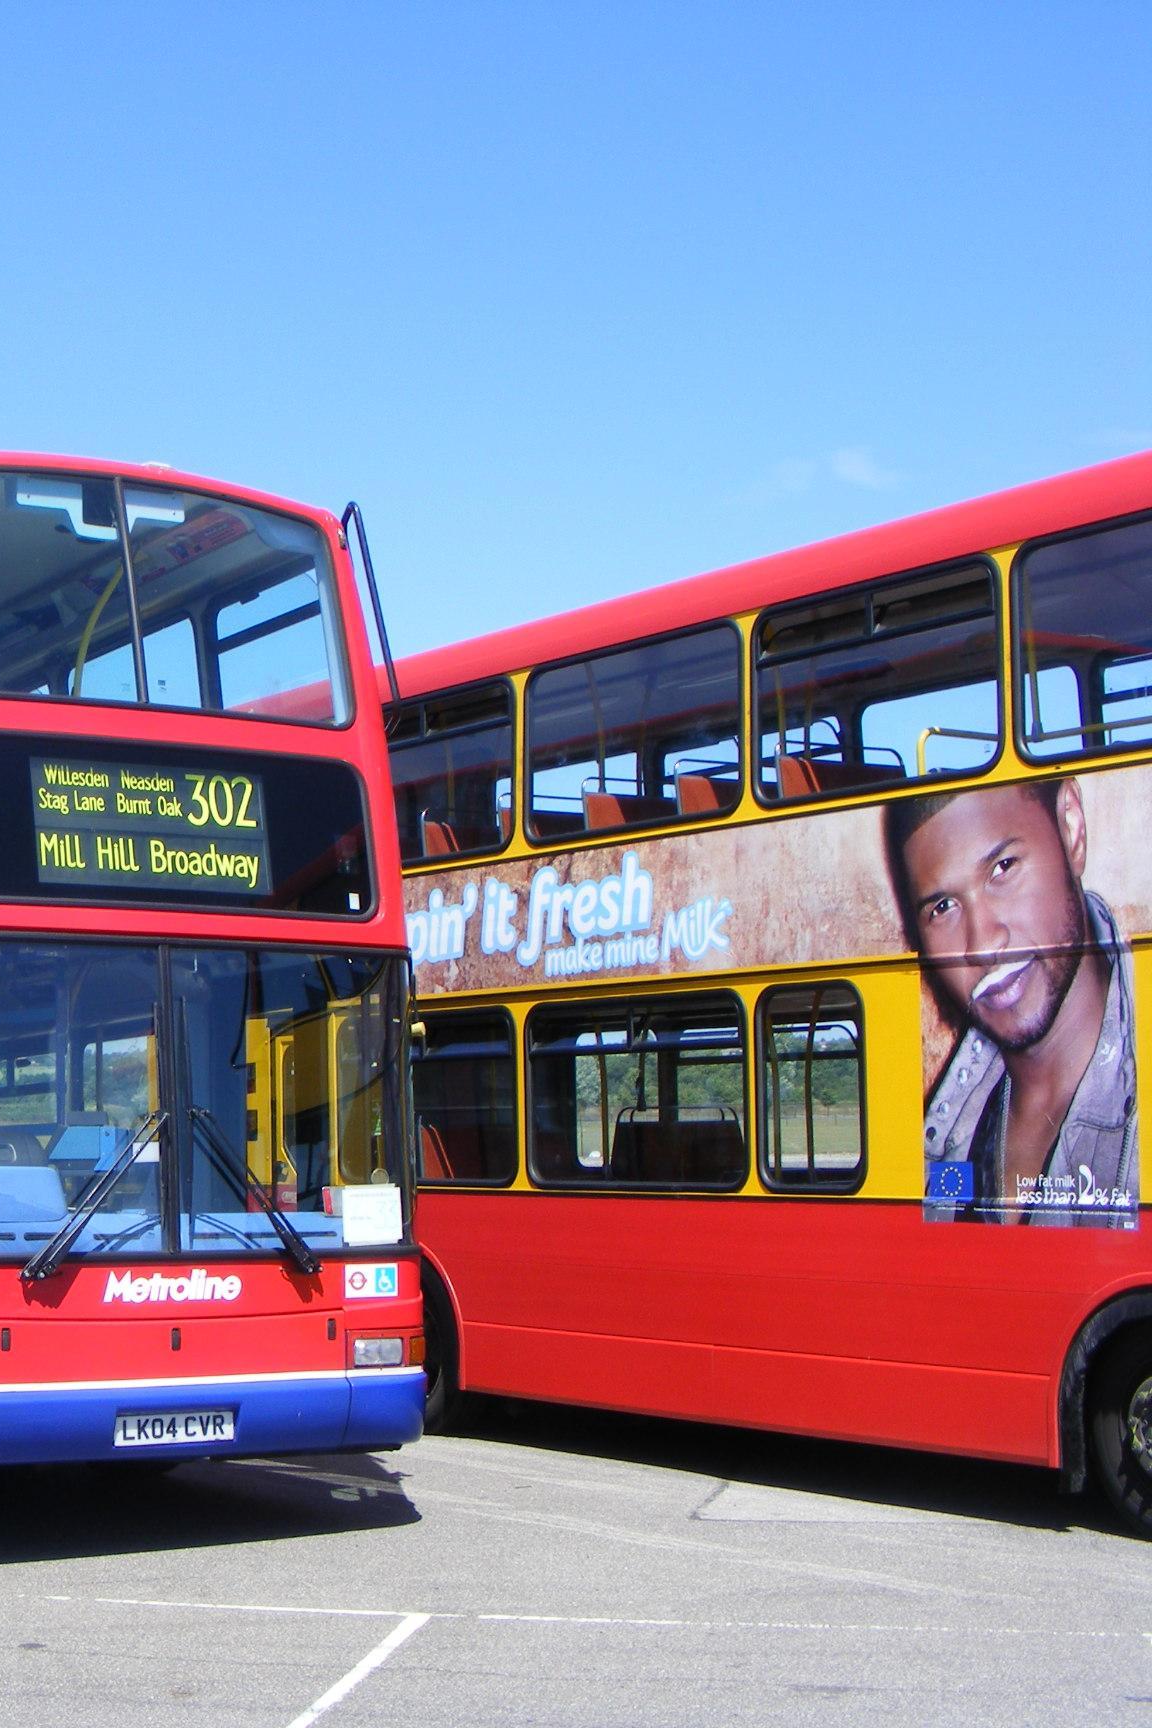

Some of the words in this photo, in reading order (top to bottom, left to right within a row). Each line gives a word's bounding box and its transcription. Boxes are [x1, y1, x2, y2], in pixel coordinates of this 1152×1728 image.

[44, 764, 109, 787] Willesden
[121, 769, 174, 793] Neasden
[39, 788, 69, 814] Stag
[74, 791, 105, 812] Lane
[117, 793, 152, 815] Burnt
[158, 796, 183, 817] Oak
[185, 774, 257, 827] 302
[39, 832, 85, 869] Mill
[97, 836, 140, 871] Hill
[150, 839, 259, 888] Broadway
[484, 881, 515, 949] it
[520, 852, 652, 963] fresh
[547, 936, 603, 975] make
[605, 932, 659, 968] mine
[1015, 1188, 1042, 1205] less
[1044, 1188, 1077, 1205] than
[1111, 1188, 1132, 1207] fat
[1016, 1174, 1037, 1188] Low
[1038, 1174, 1053, 1188] fat
[1055, 1174, 1076, 1188] milk
[103, 1268, 242, 1303] Metroline
